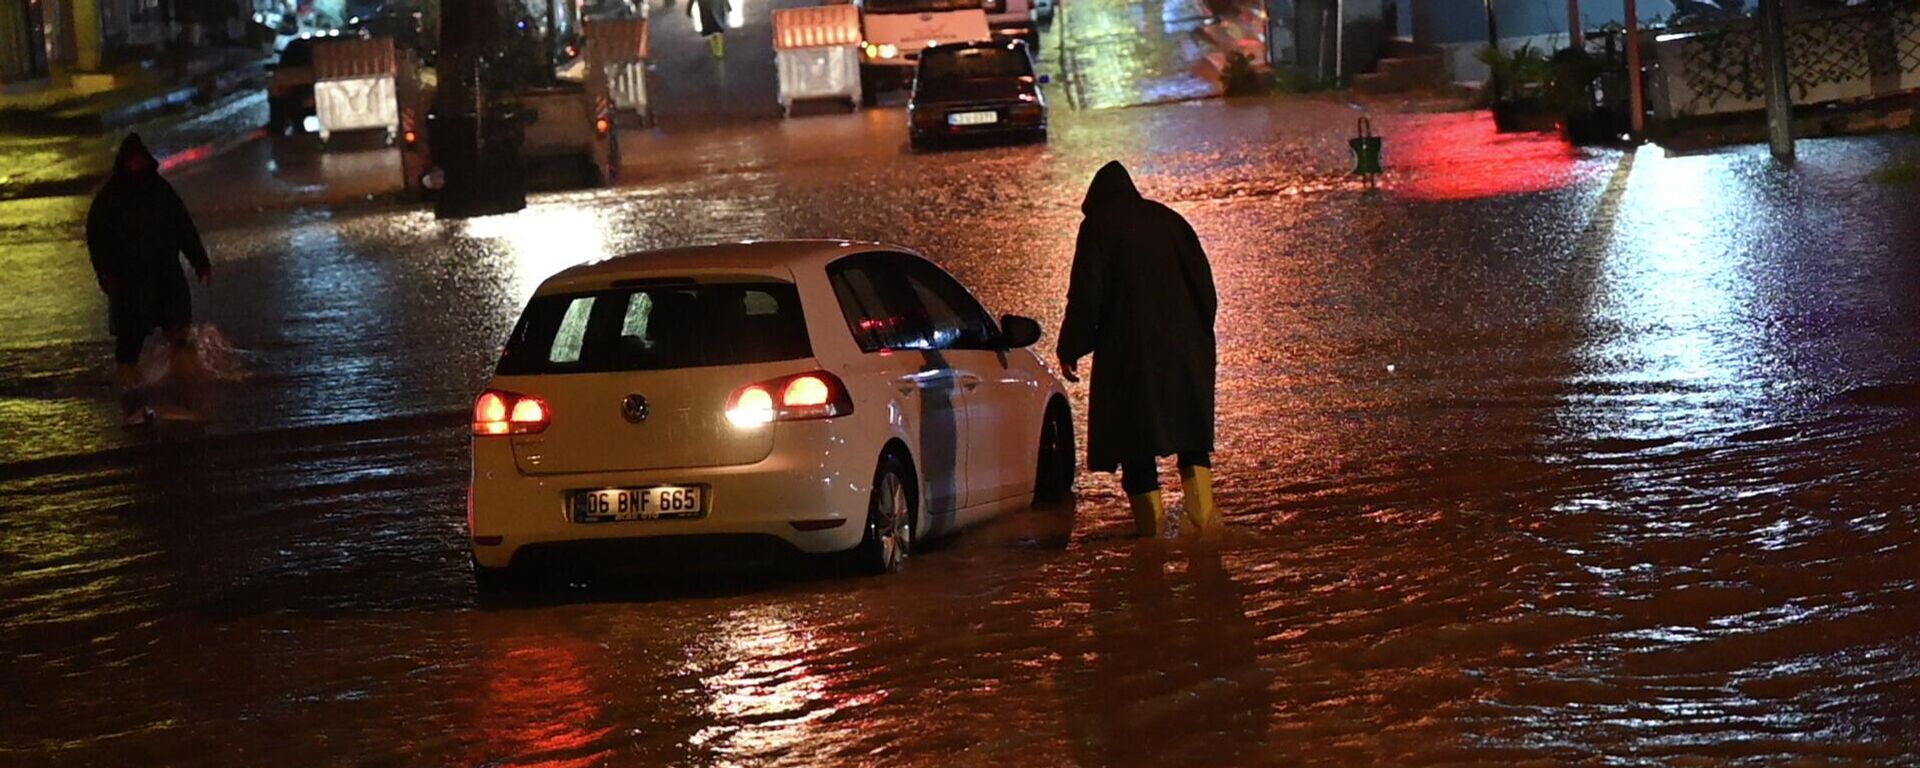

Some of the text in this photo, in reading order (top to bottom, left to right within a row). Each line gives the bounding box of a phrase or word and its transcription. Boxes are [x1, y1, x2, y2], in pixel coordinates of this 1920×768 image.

[588, 489, 695, 513] 06 BNF 665
